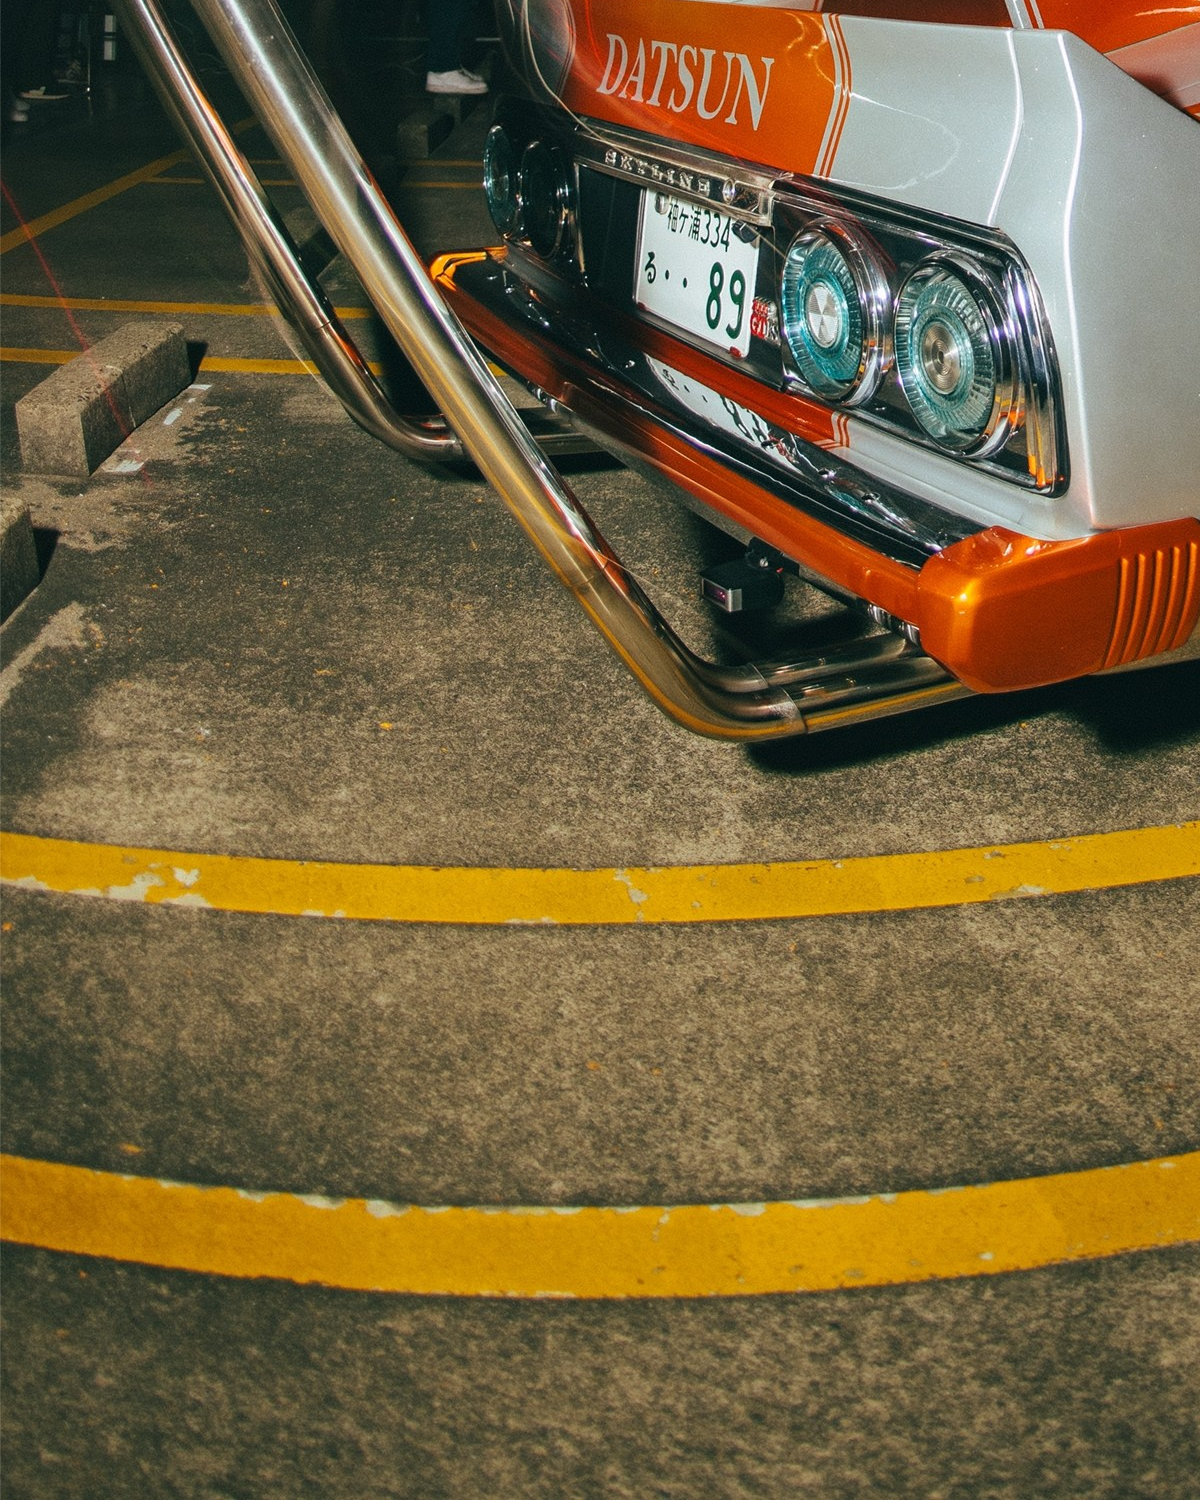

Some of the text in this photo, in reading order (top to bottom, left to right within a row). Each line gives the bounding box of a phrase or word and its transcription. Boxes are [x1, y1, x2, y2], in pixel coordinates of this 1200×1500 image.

[596, 33, 775, 131] DATSUN
[605, 149, 710, 196] SKYLINE
[706, 261, 746, 339] 89
